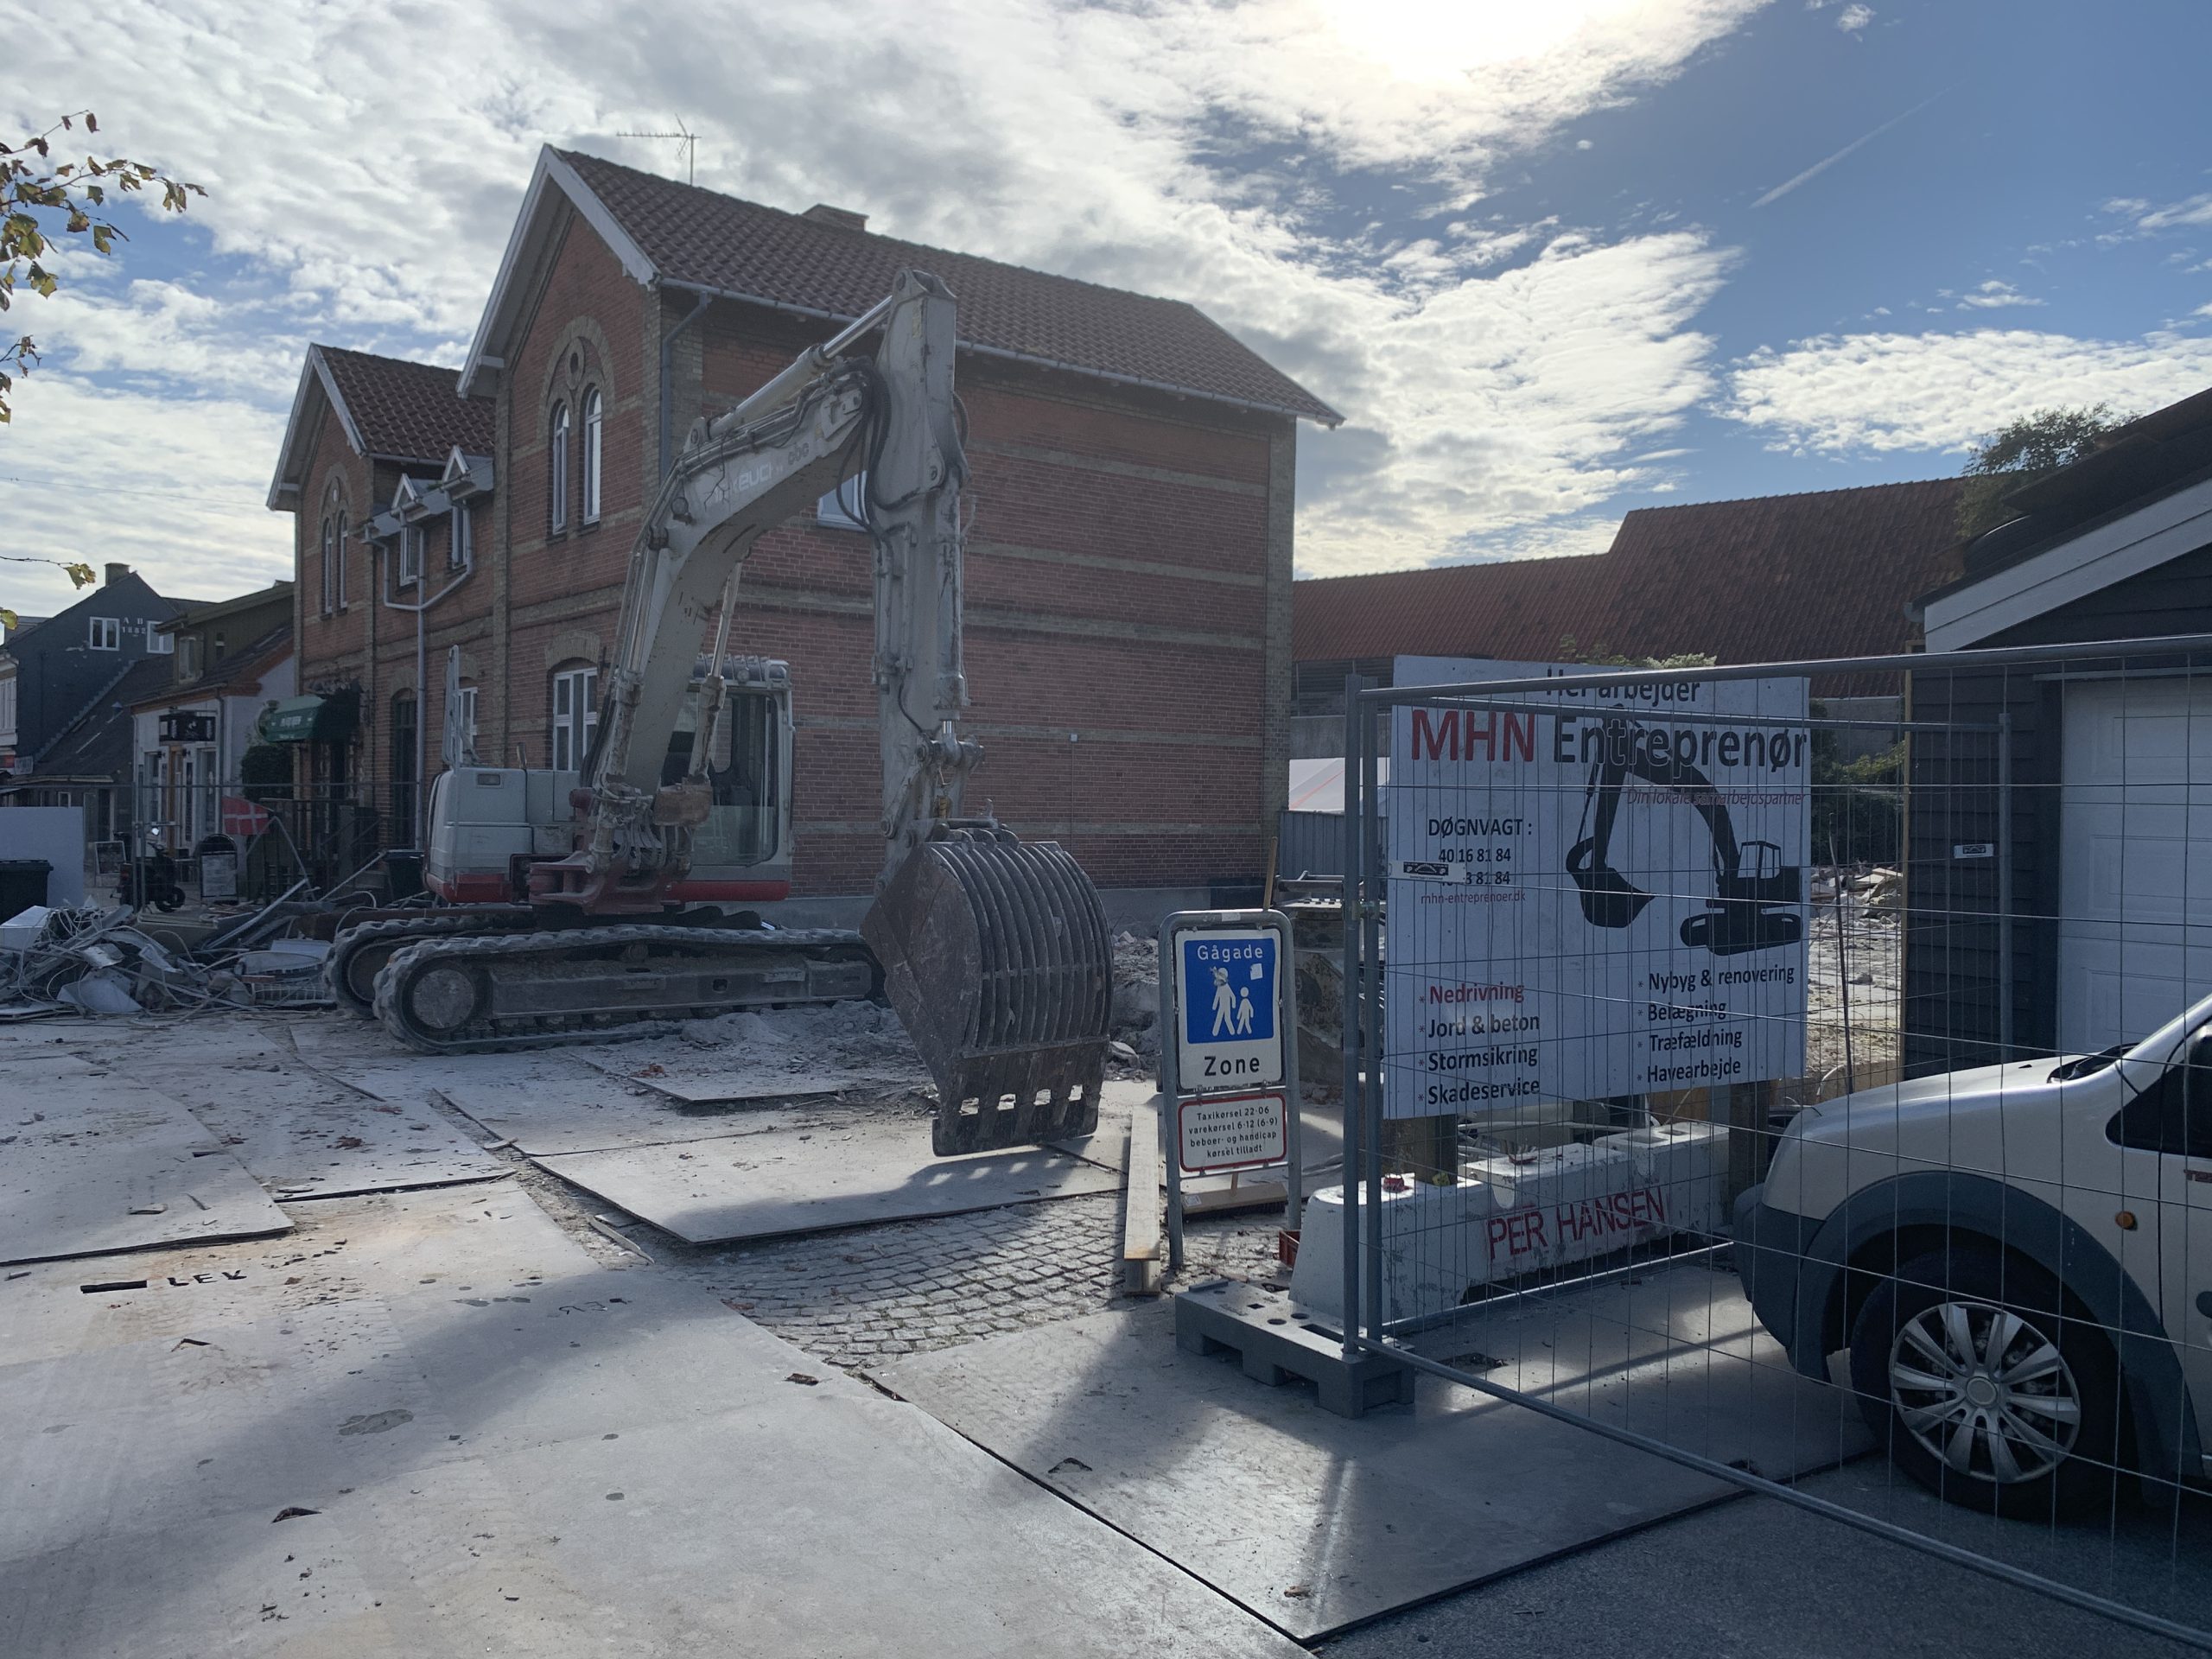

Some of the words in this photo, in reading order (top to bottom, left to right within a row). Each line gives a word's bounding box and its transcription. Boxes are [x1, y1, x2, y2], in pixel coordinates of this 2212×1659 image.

[1412, 709, 1535, 762] MHN
[1554, 715, 1808, 779] Entreprenør
[1627, 788, 1649, 805] Din
[1652, 788, 1691, 805] lokale
[1428, 817, 1523, 838] DØGNVAGT
[1439, 849, 1454, 862] 40
[1459, 849, 1473, 862] 16
[1477, 849, 1491, 862] 81
[1496, 848, 1511, 861] 84
[1476, 871, 1491, 885] 81
[1495, 871, 1510, 885] 84
[1421, 890, 1526, 905] mhn-entreprenoer.dk
[1197, 944, 1263, 963] Gågade
[1649, 971, 1696, 994] Nybyg
[1700, 969, 1713, 988] &
[1719, 964, 1795, 985] renovering
[1430, 981, 1525, 1005] Nedrivning
[1648, 1000, 1727, 1022] Belægning
[1428, 1015, 1466, 1039] Jord
[1471, 1015, 1485, 1034] &
[1491, 1014, 1540, 1033] beton
[1649, 1028, 1743, 1052] Træfældning
[1204, 1056, 1260, 1077] Zone
[1428, 1046, 1538, 1071] Stormsikring
[1648, 1057, 1741, 1083] Havearbejde
[1427, 1077, 1540, 1105] Skadeservice
[1197, 1109, 1242, 1122] Taxikørsel
[1189, 1122, 1235, 1135] varekørsel
[1227, 1135, 1236, 1144] og
[1239, 1130, 1277, 1142] handicap
[1207, 1147, 1234, 1158] kørsel
[1236, 1144, 1262, 1155] tilladt
[1486, 1211, 1548, 1261] PER
[1556, 1186, 1667, 1242] HANSEN
